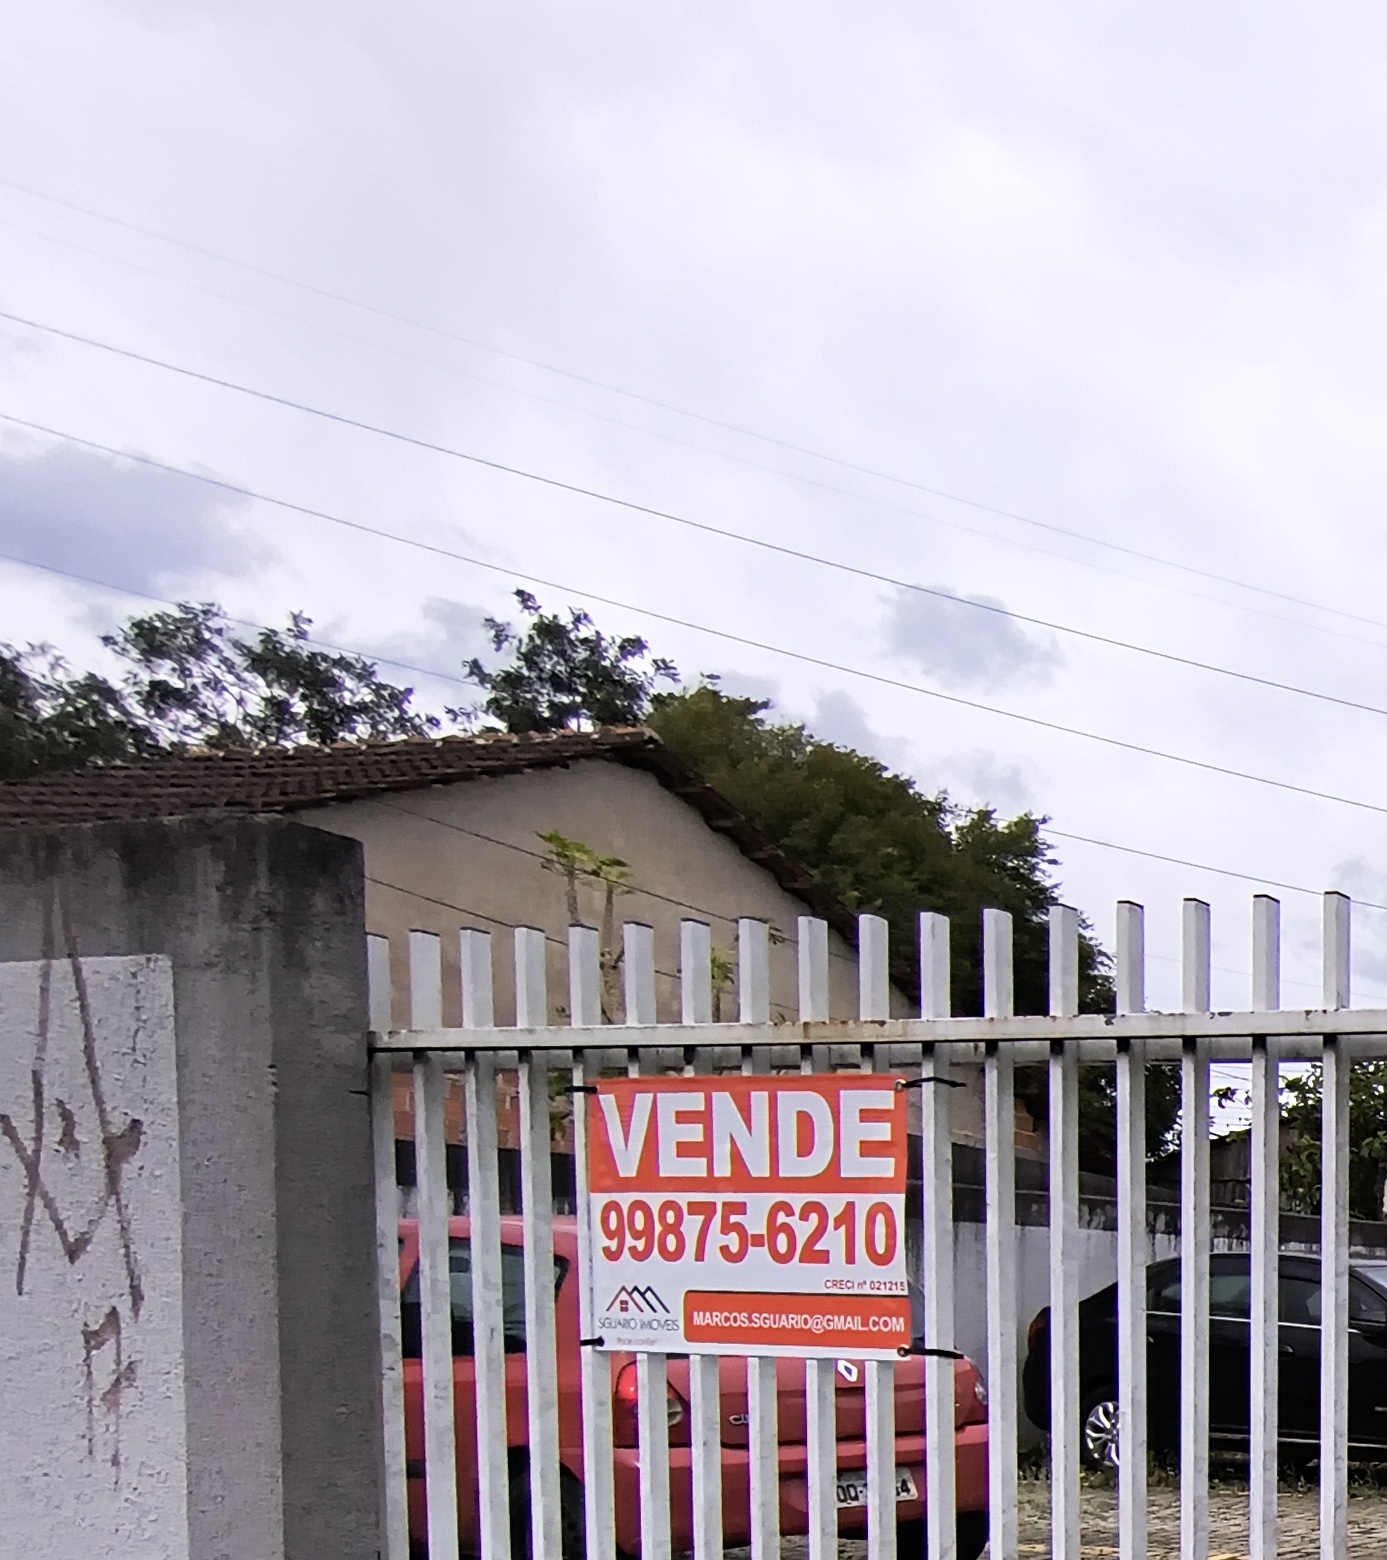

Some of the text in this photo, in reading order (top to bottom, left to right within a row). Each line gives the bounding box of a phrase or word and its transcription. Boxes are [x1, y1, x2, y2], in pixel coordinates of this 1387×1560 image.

[598, 1088, 896, 1179] VENDE
[600, 1199, 898, 1267] 99875-6210
[824, 1279, 855, 1290] CRECI
[869, 1280, 906, 1292] 021215
[693, 1311, 905, 1334] MARCOS.SGUARIO@GMAIL.COM
